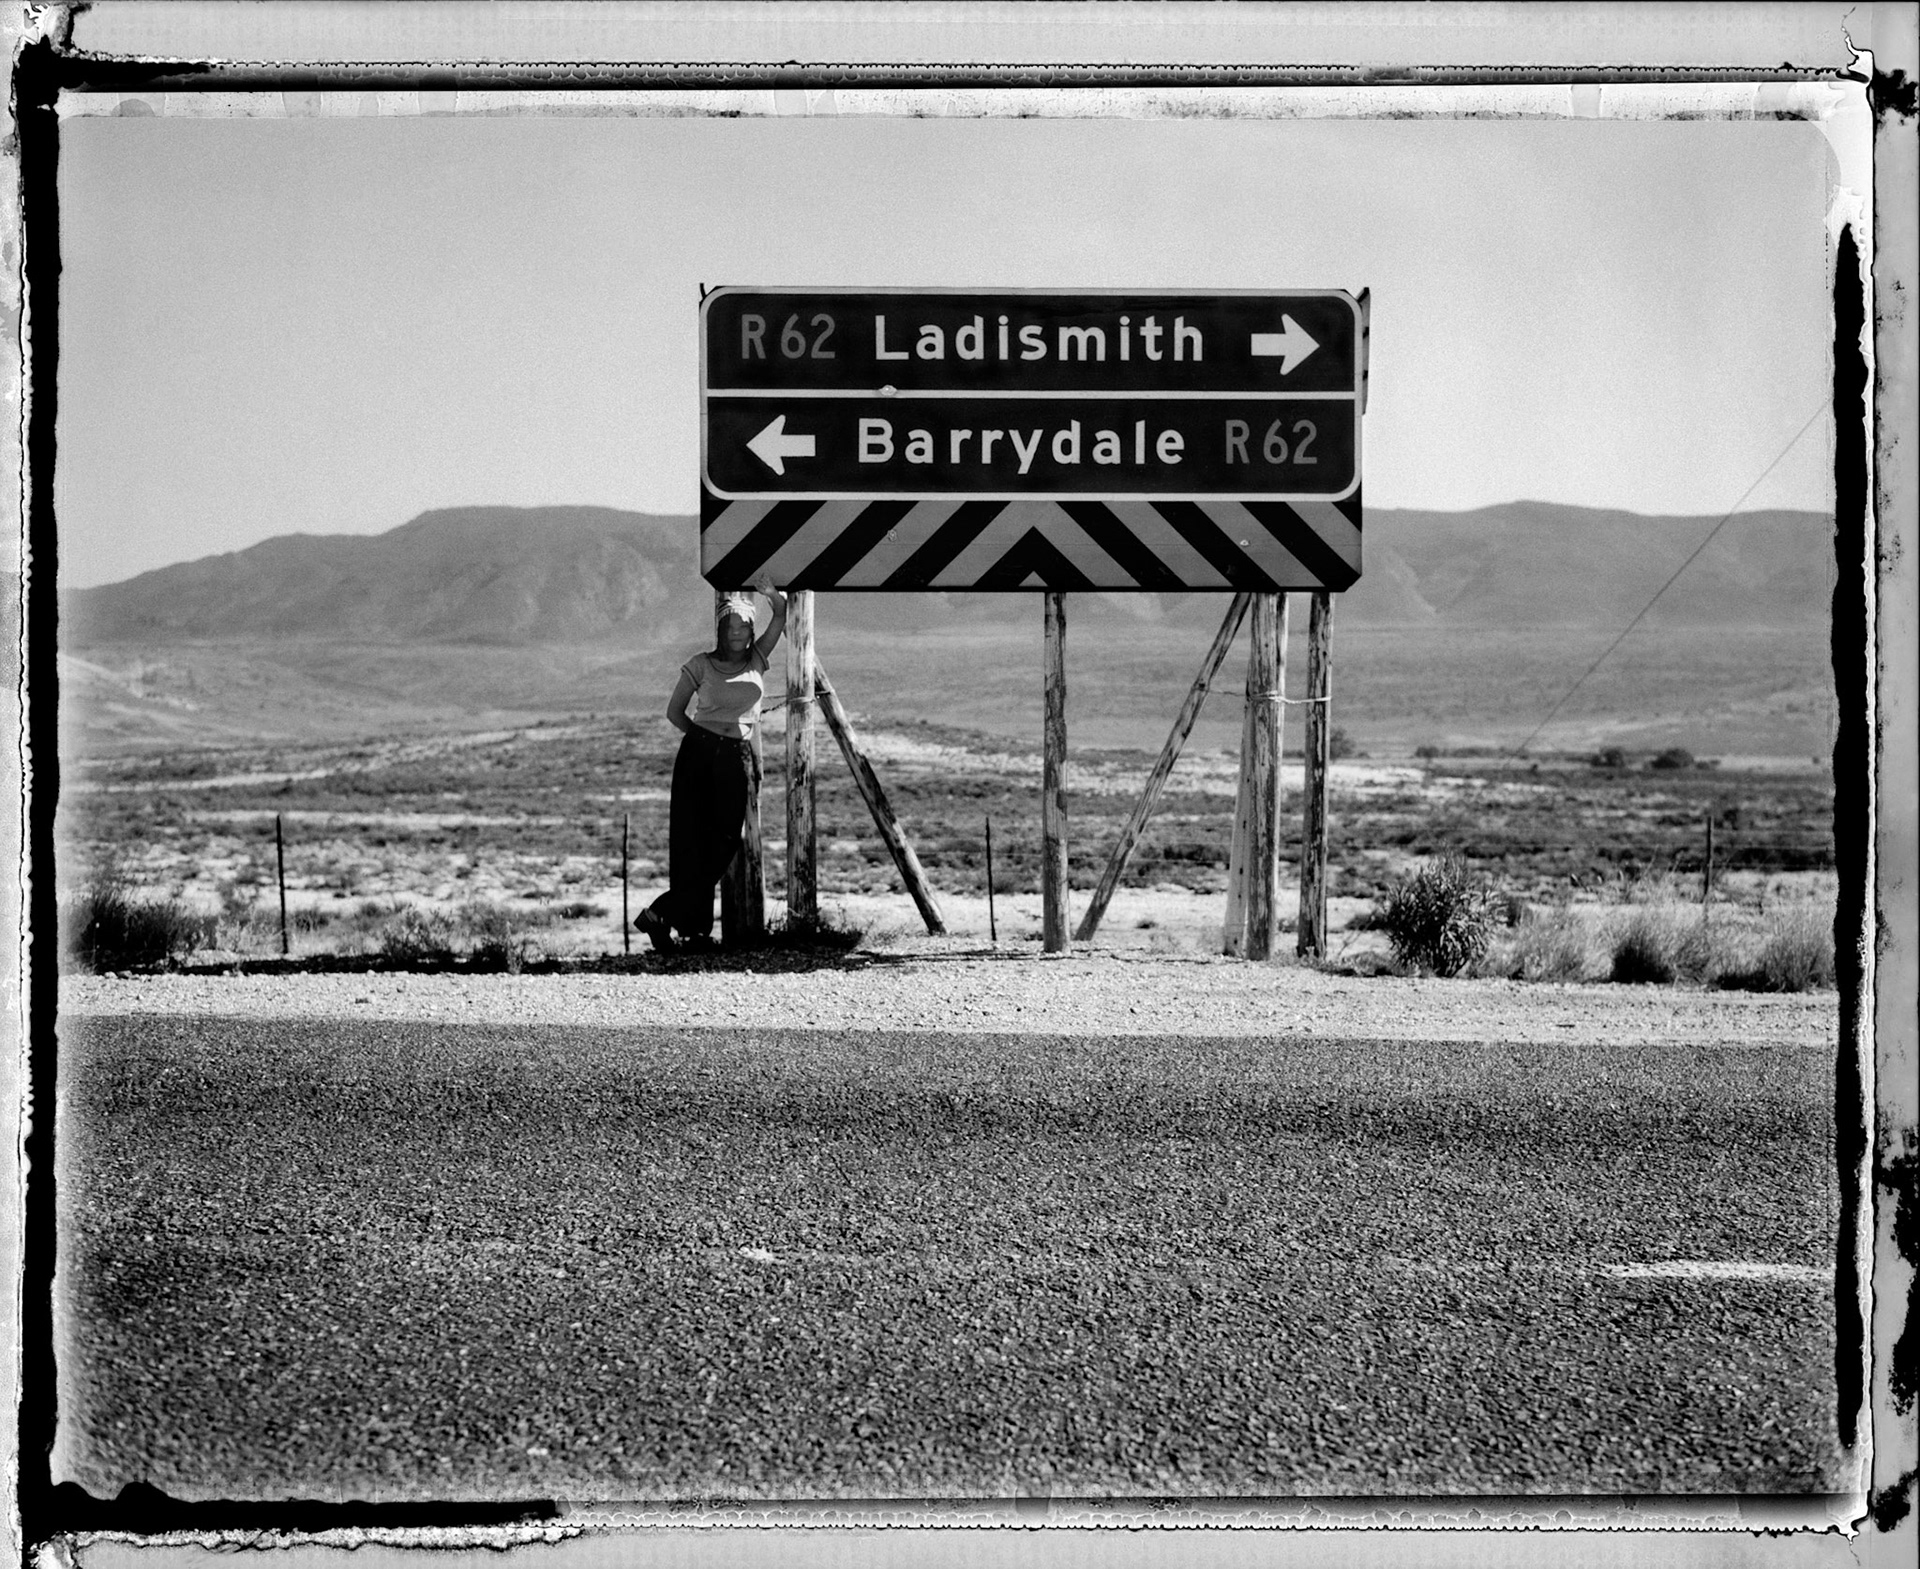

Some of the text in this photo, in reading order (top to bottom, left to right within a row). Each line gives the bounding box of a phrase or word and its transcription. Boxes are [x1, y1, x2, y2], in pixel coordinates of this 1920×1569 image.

[741, 313, 1205, 362] R 62 Ladismith
[858, 418, 1318, 475] Barrydale R 62
